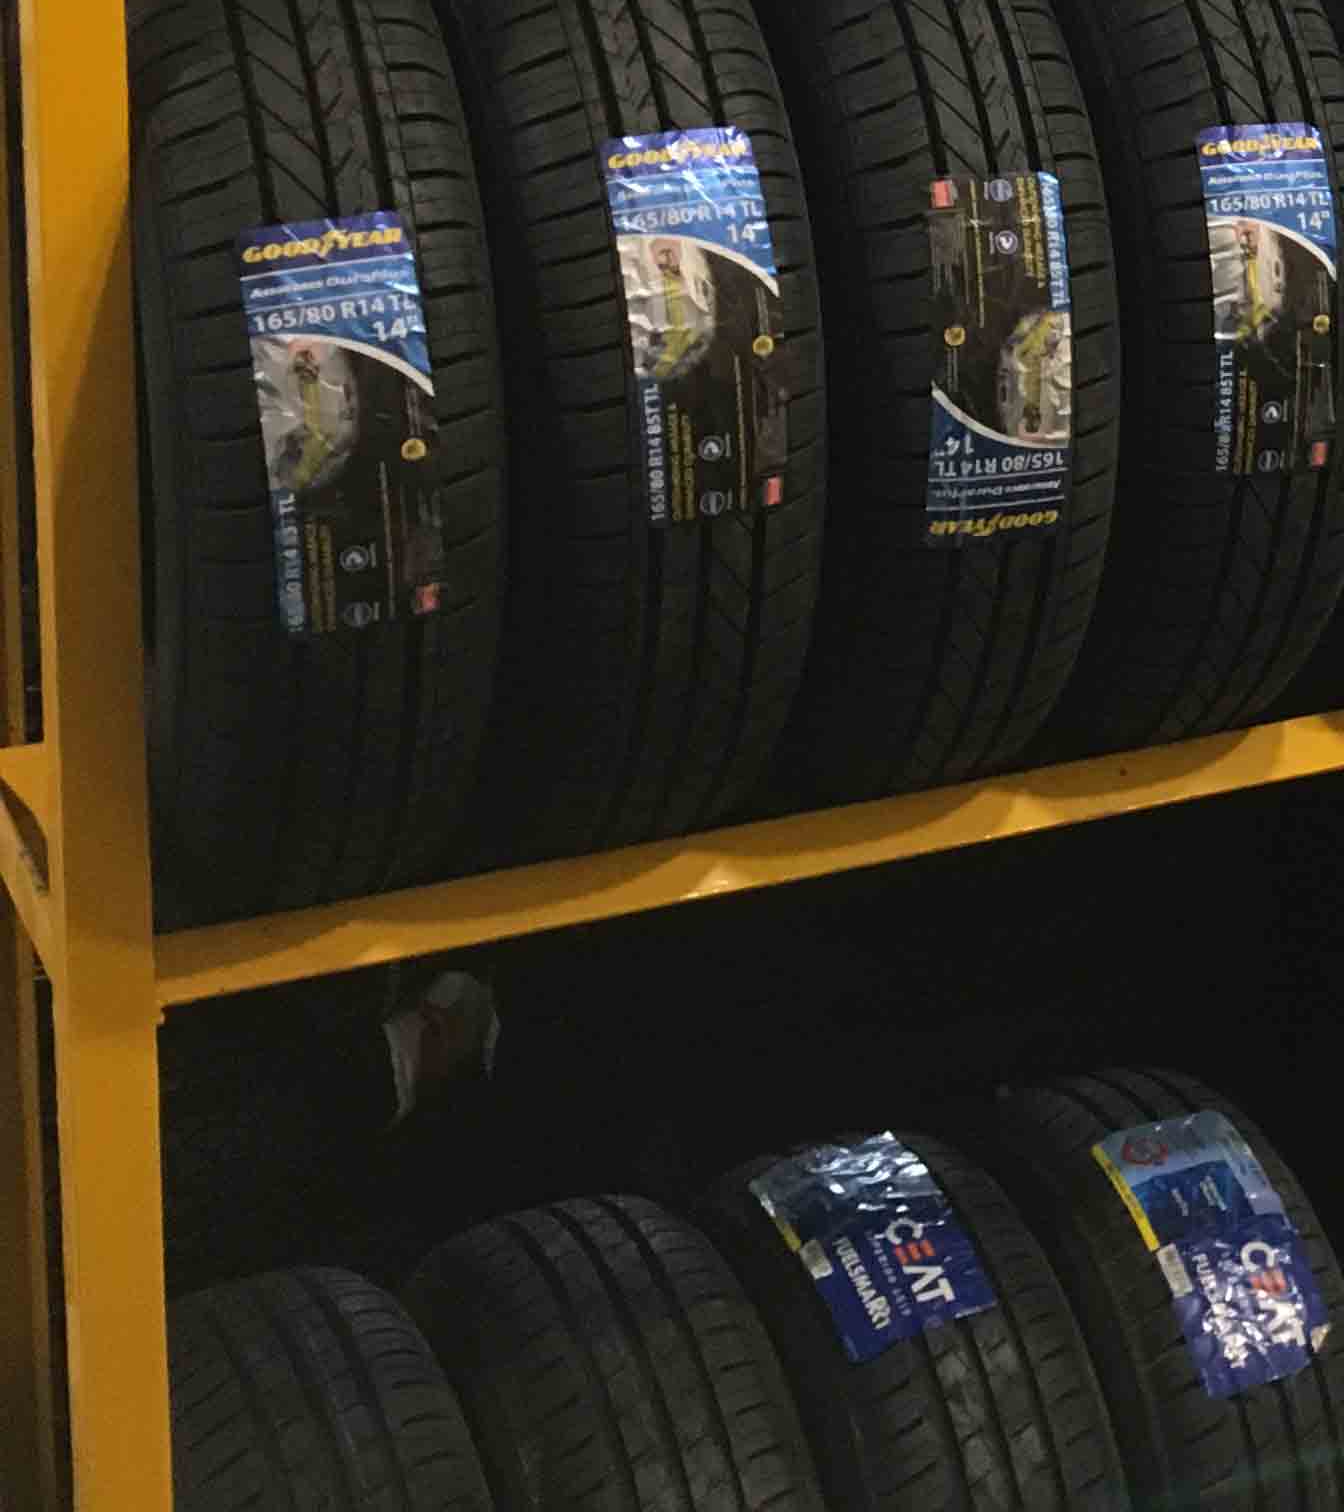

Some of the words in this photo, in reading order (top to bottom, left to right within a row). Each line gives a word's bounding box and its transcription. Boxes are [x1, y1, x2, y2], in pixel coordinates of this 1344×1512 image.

[1210, 194, 1272, 213] 165/80
[242, 227, 402, 263] GOODYEAR
[254, 306, 336, 334] 165/80
[341, 297, 385, 320] R14
[935, 459, 957, 478] TL
[962, 457, 998, 475] R14
[1002, 451, 1064, 473] 165/80
[648, 470, 666, 521] 165/80
[883, 1218, 956, 1304] CEAT
